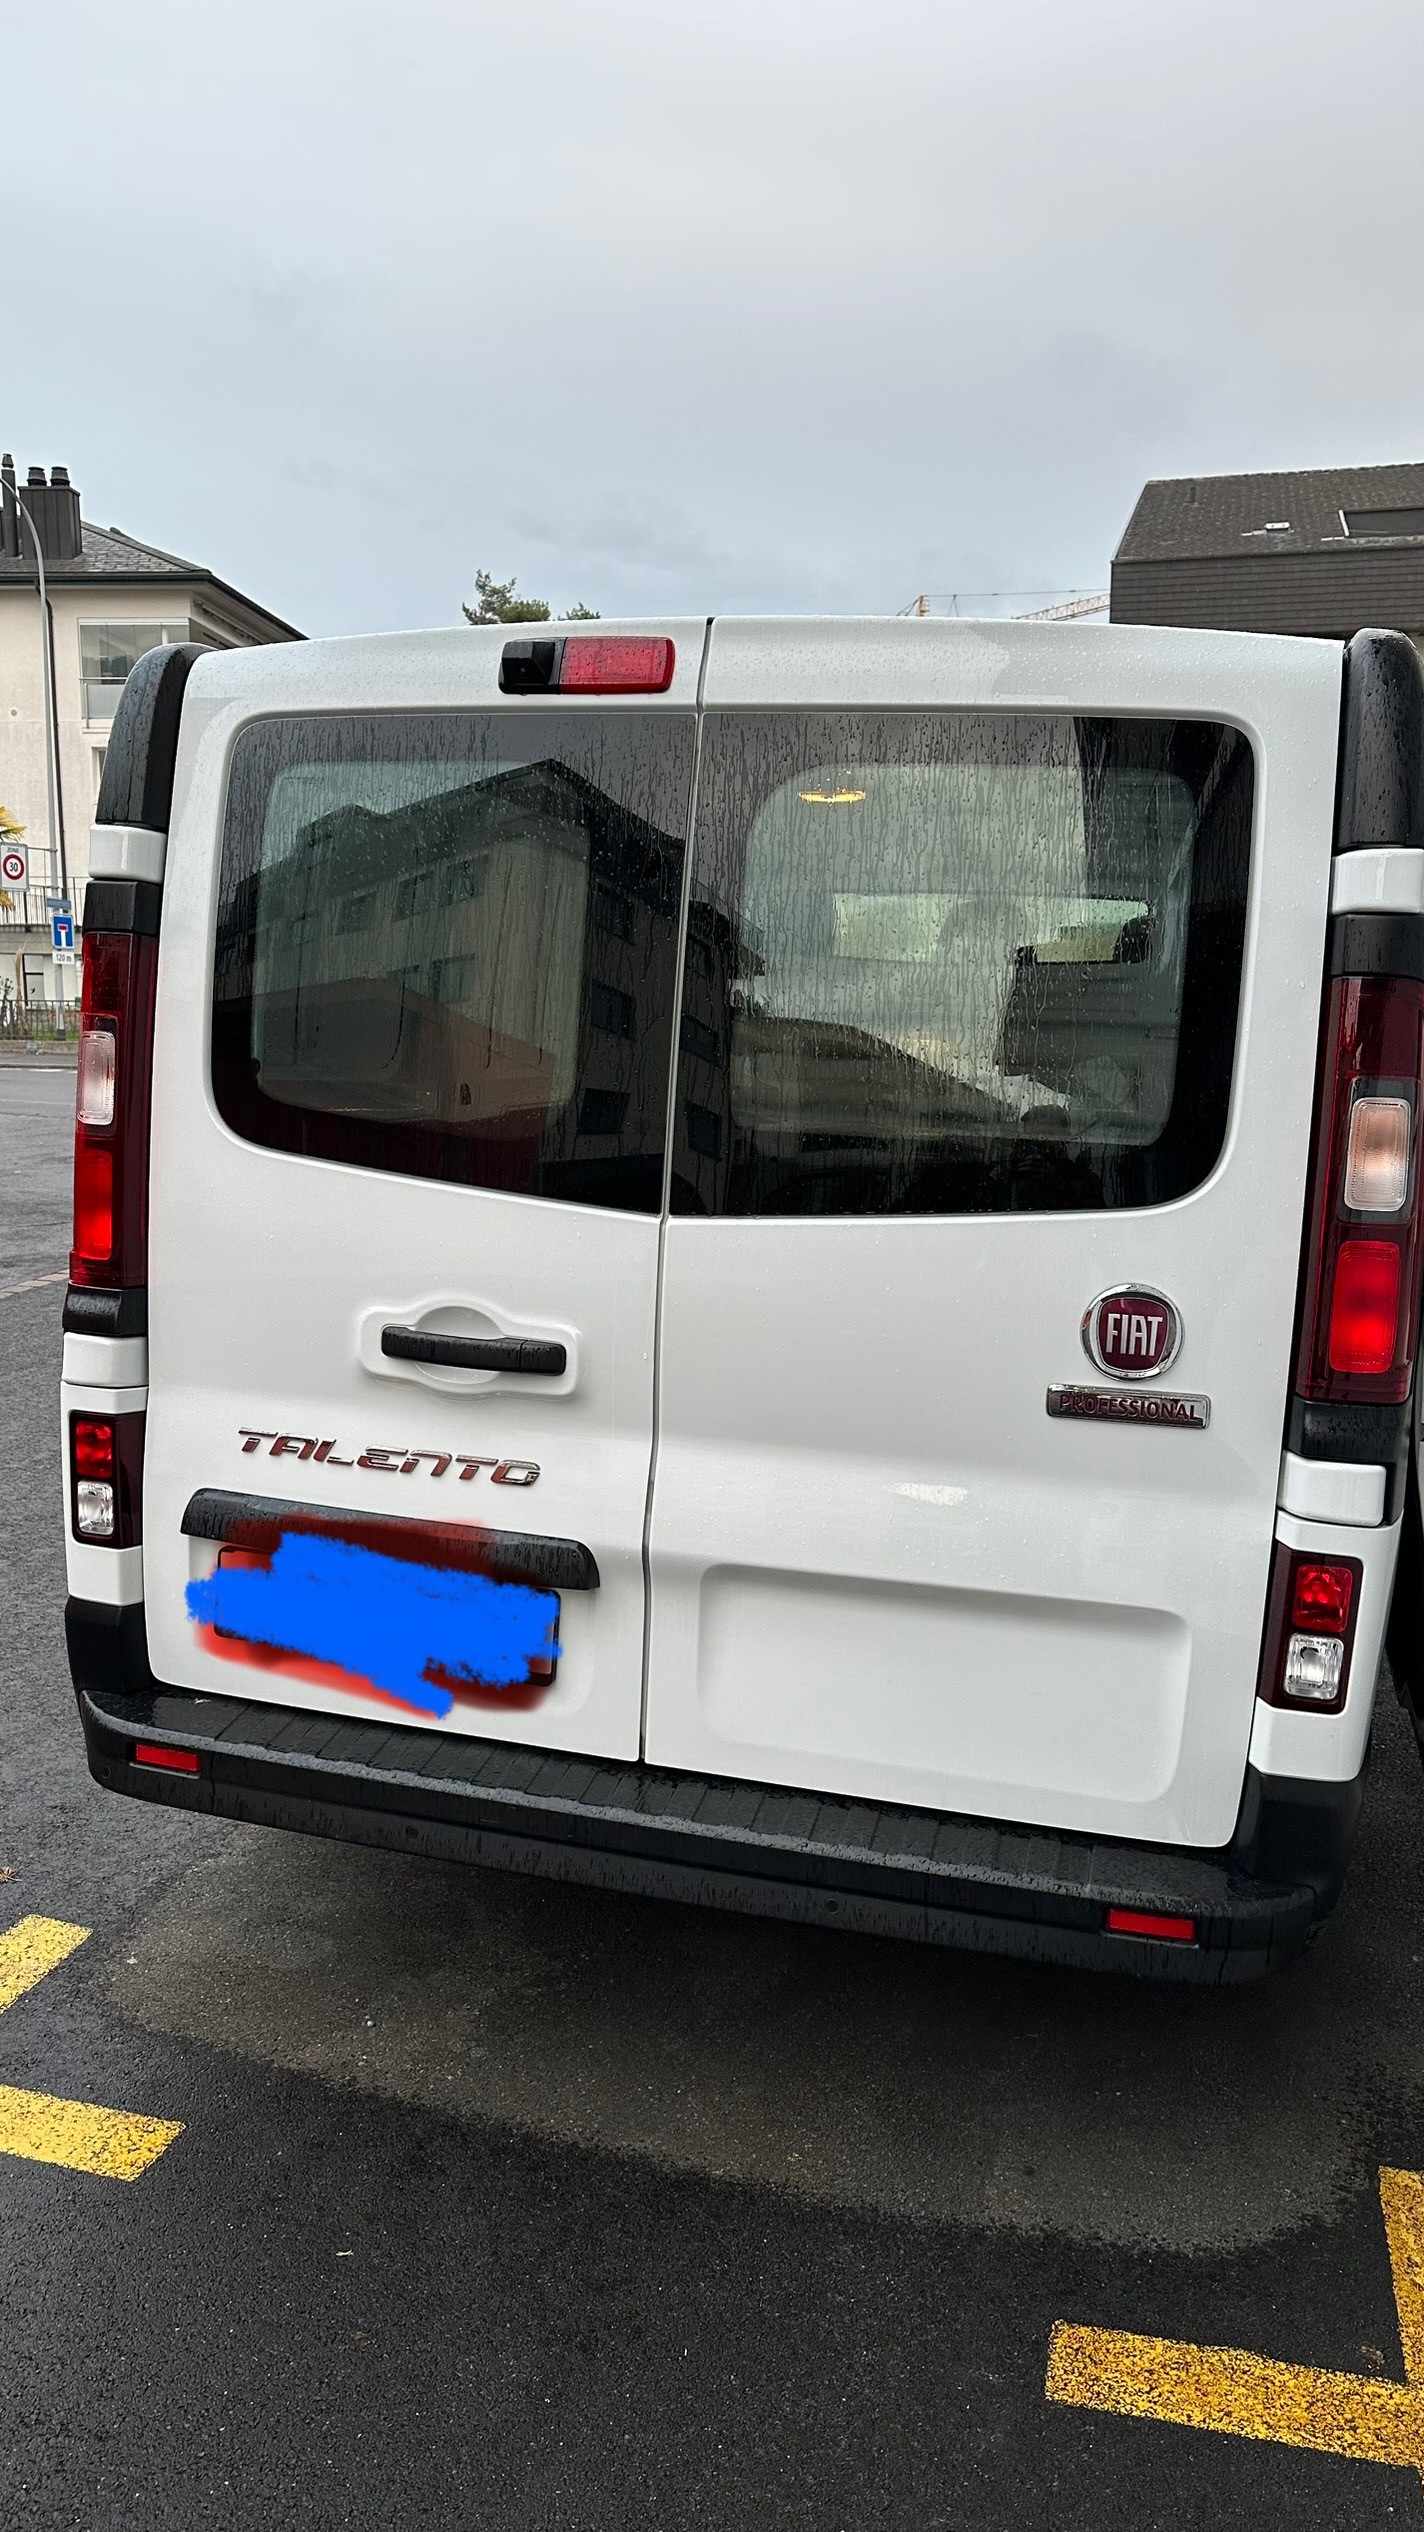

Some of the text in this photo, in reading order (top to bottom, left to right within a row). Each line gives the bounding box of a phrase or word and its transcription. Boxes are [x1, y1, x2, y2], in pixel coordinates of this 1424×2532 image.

[10, 862, 18, 872] 30
[56, 953, 65, 962] 120
[1106, 1313, 1163, 1357] FIAT
[1059, 1394, 1200, 1422] PROFESSIONAL
[239, 1427, 541, 1487] TALENTO
